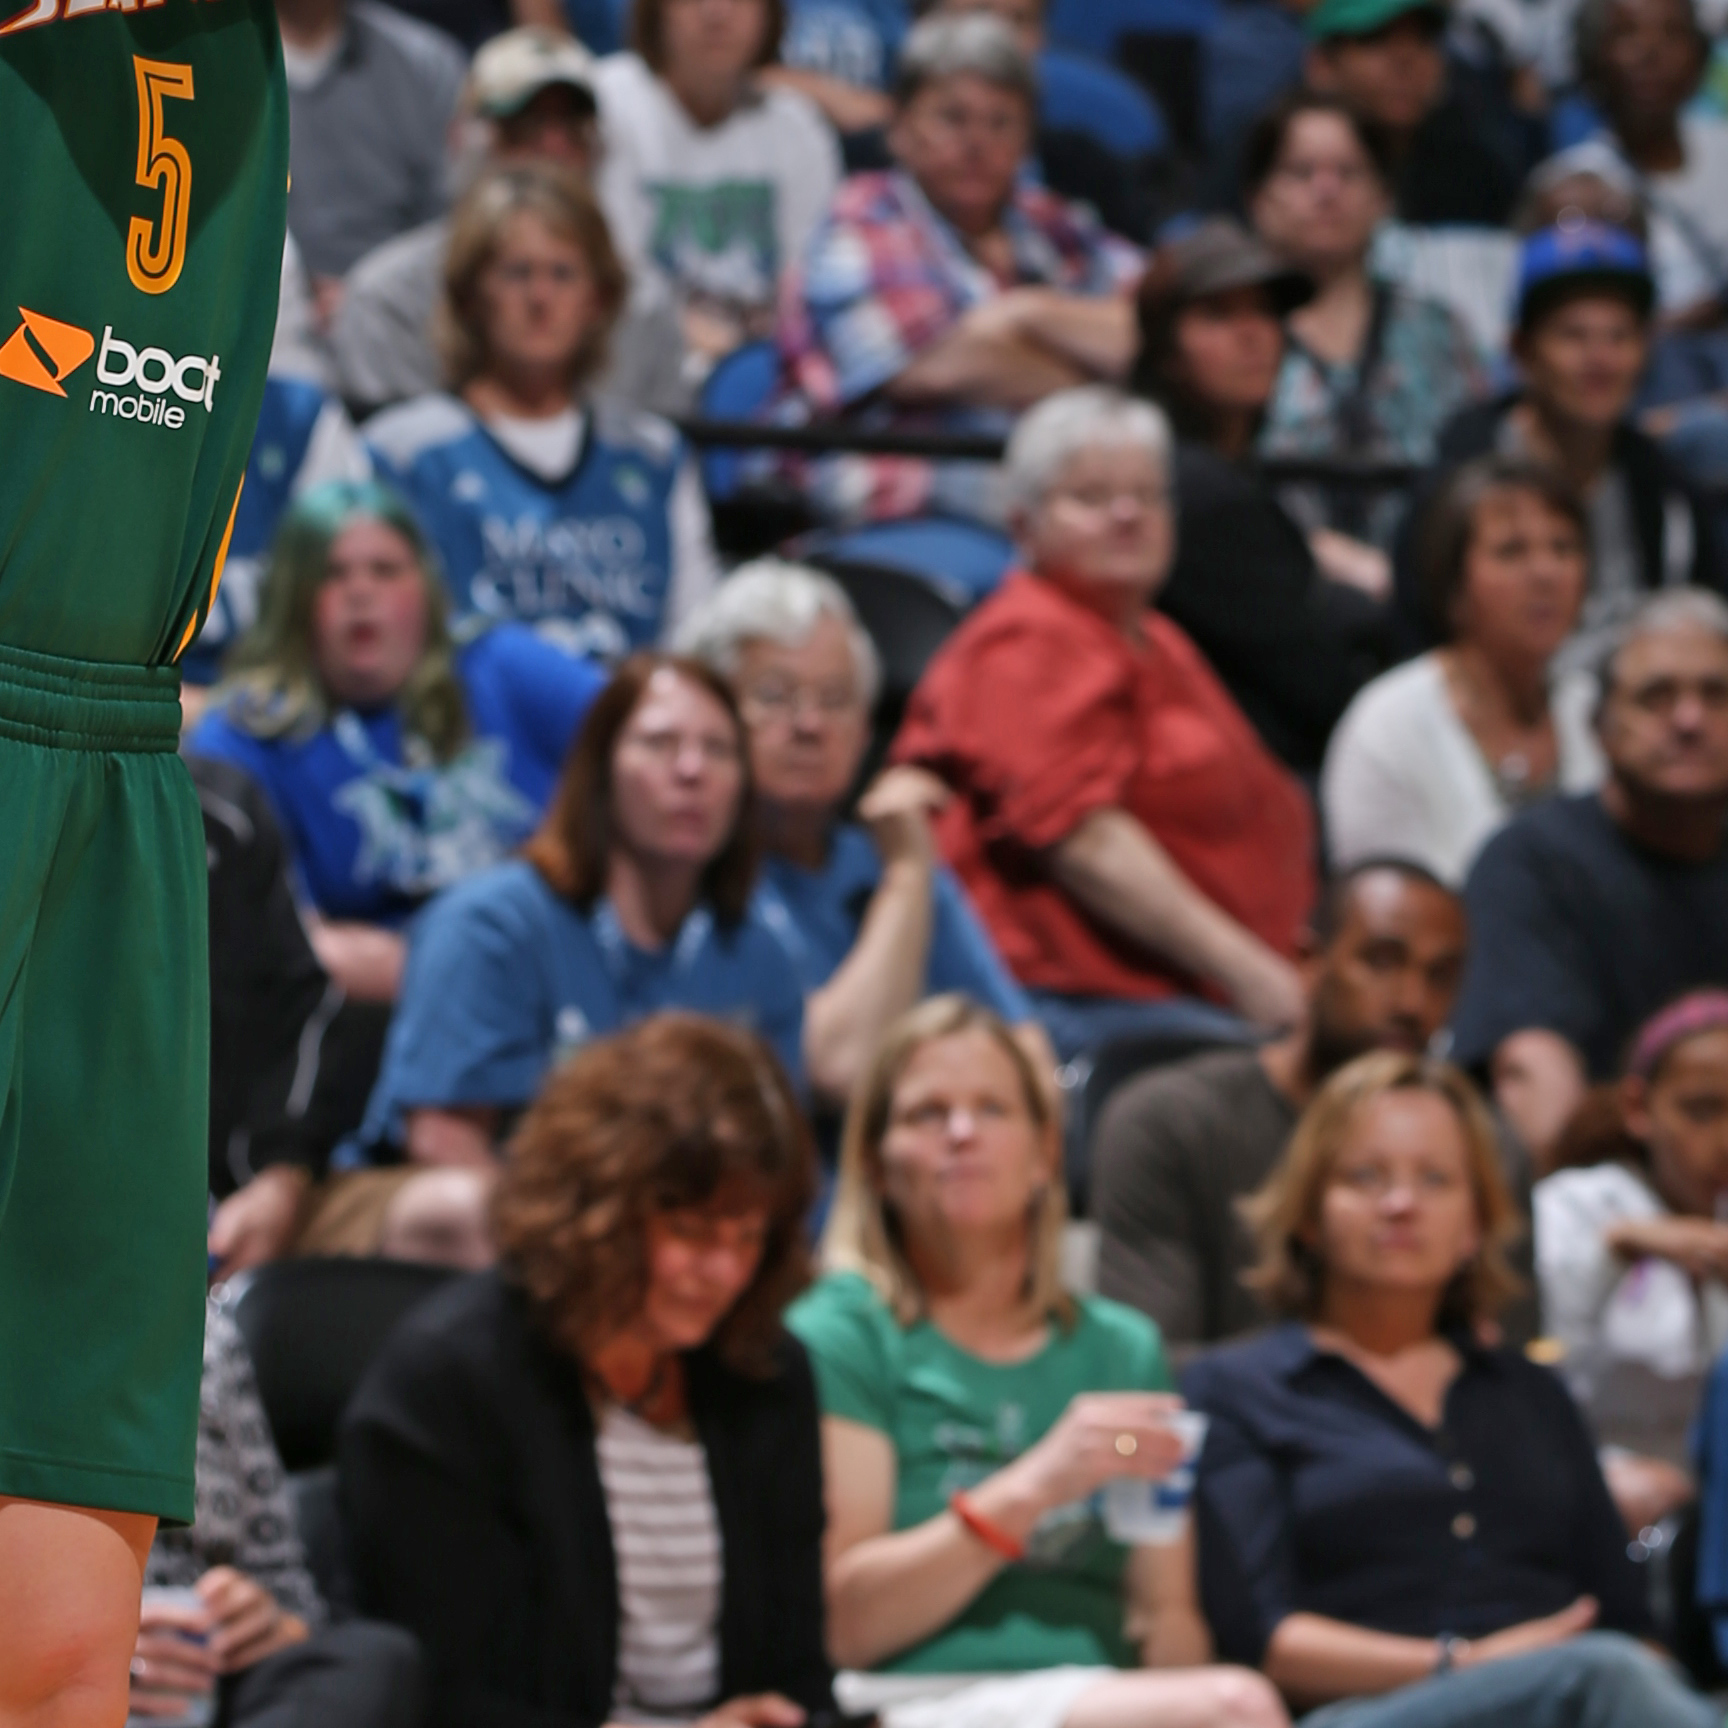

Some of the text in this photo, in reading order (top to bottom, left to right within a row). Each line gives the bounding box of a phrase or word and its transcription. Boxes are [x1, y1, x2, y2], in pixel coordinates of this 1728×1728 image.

[125, 54, 195, 295] 5
[89, 389, 186, 430] mobile
[96, 324, 222, 413] boot
